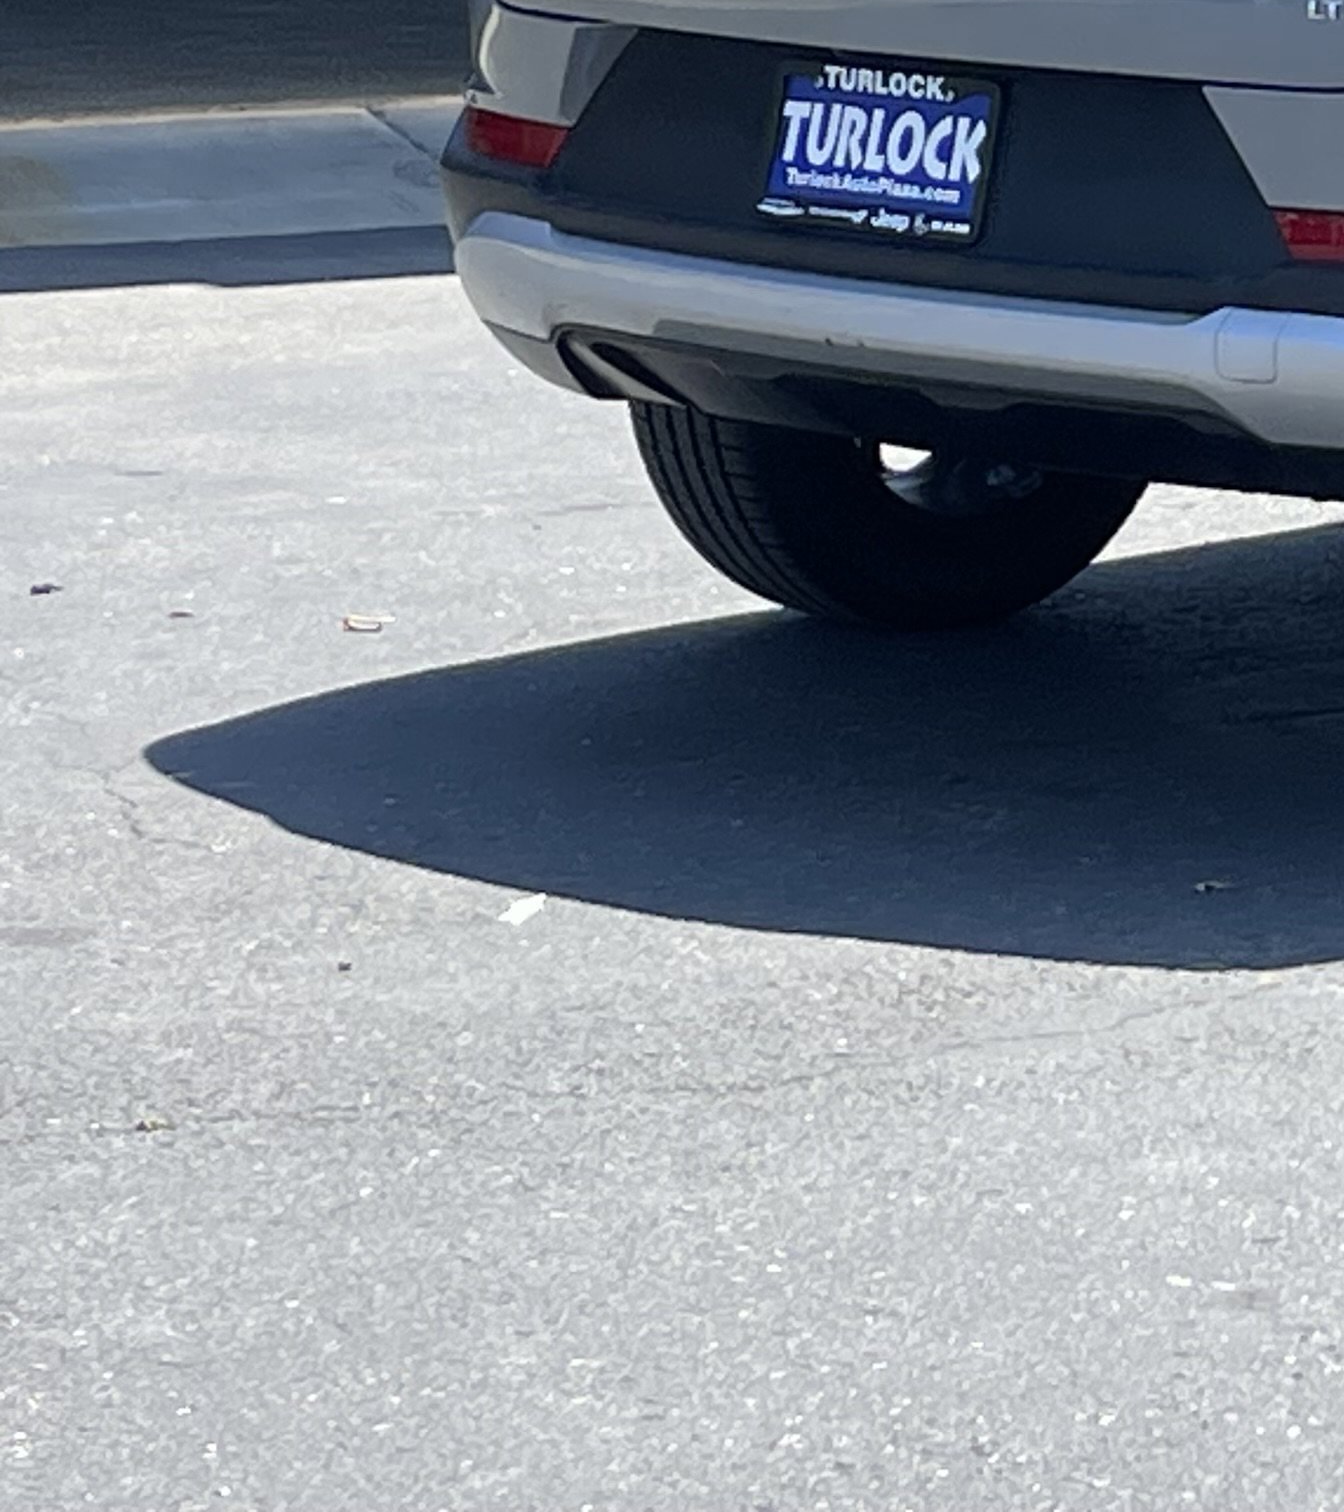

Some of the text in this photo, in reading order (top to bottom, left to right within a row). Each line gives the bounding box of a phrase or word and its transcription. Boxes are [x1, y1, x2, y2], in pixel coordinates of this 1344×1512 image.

[1307, 0, 1343, 20] LT
[823, 64, 946, 101] TURLOCK
[782, 99, 987, 183] TURLOCK
